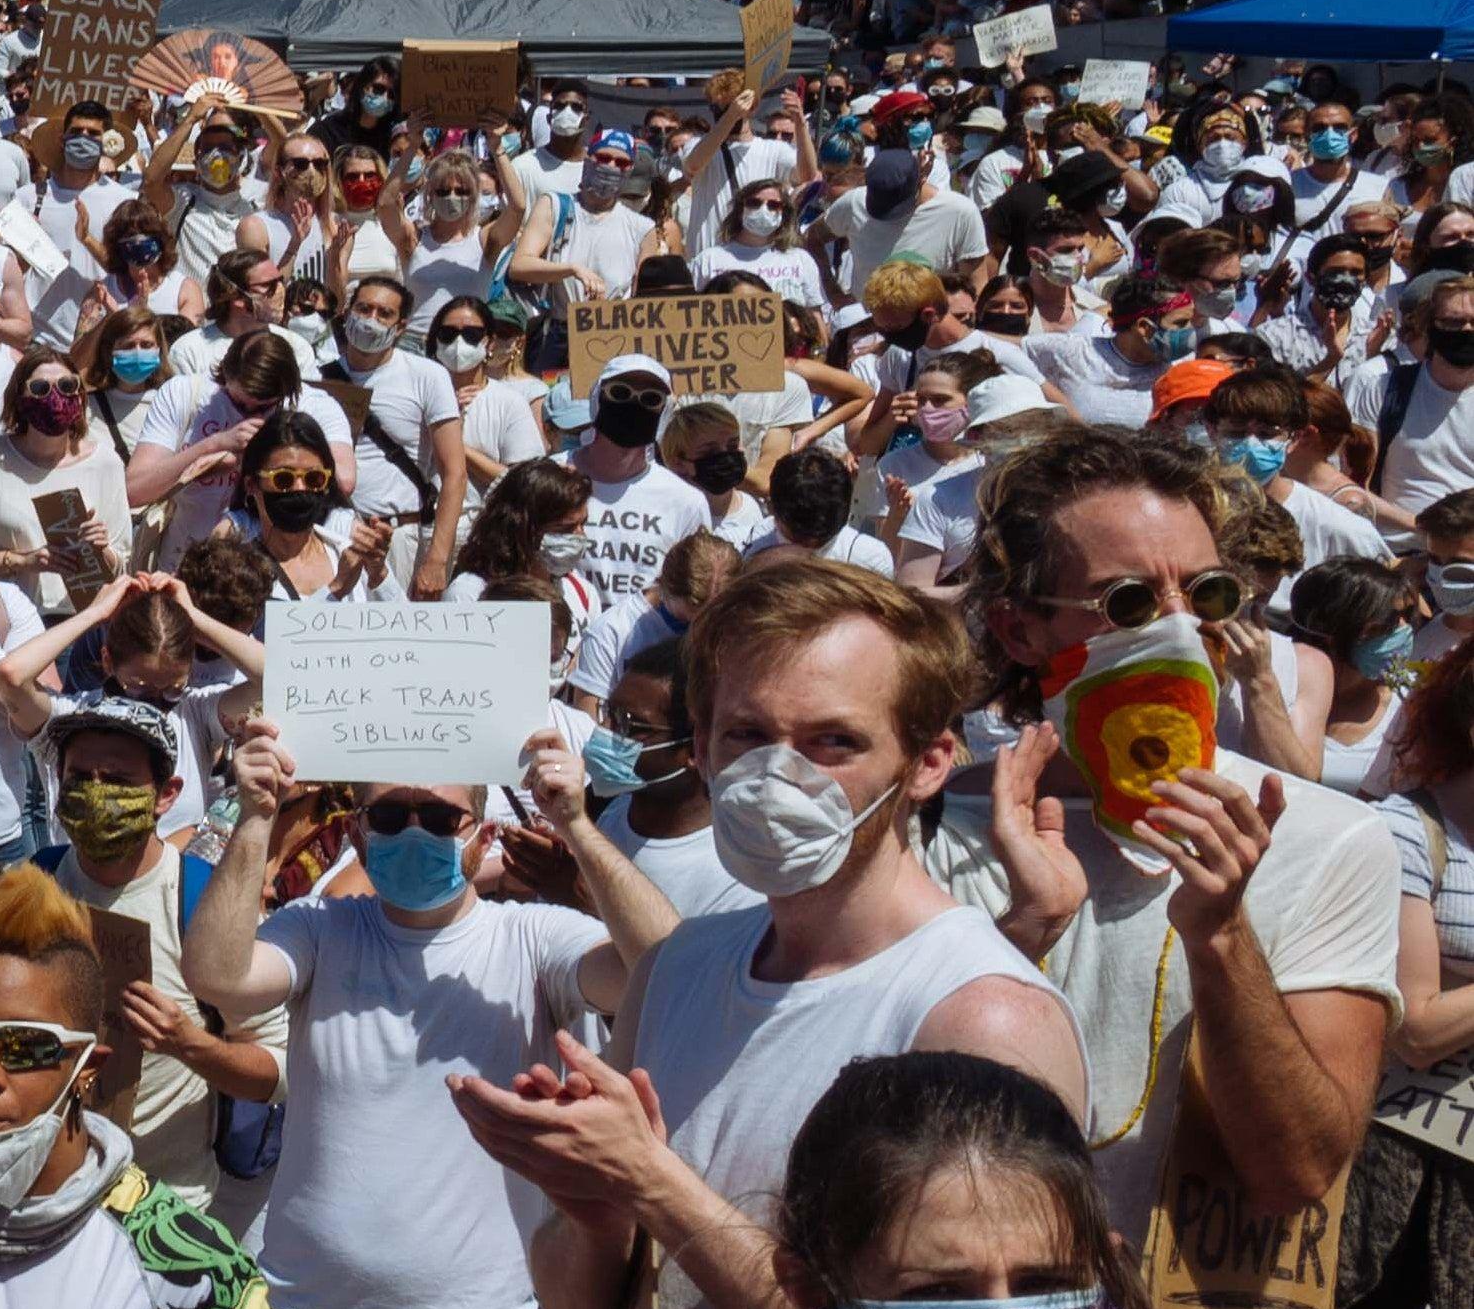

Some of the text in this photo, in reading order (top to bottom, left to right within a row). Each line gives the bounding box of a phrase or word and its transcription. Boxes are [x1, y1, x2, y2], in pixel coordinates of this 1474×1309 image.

[50, 8, 153, 50] TRANS
[574, 292, 778, 337] BLACK TRANS
[633, 330, 729, 364] LIVES
[671, 361, 742, 396] TTER
[284, 603, 506, 638] SOLIDARITY
[290, 650, 420, 671] WITH OUR
[285, 685, 494, 712] BLACK TRANS
[333, 720, 475, 745] SIBLINGS
[1165, 1170, 1330, 1291] POWER
